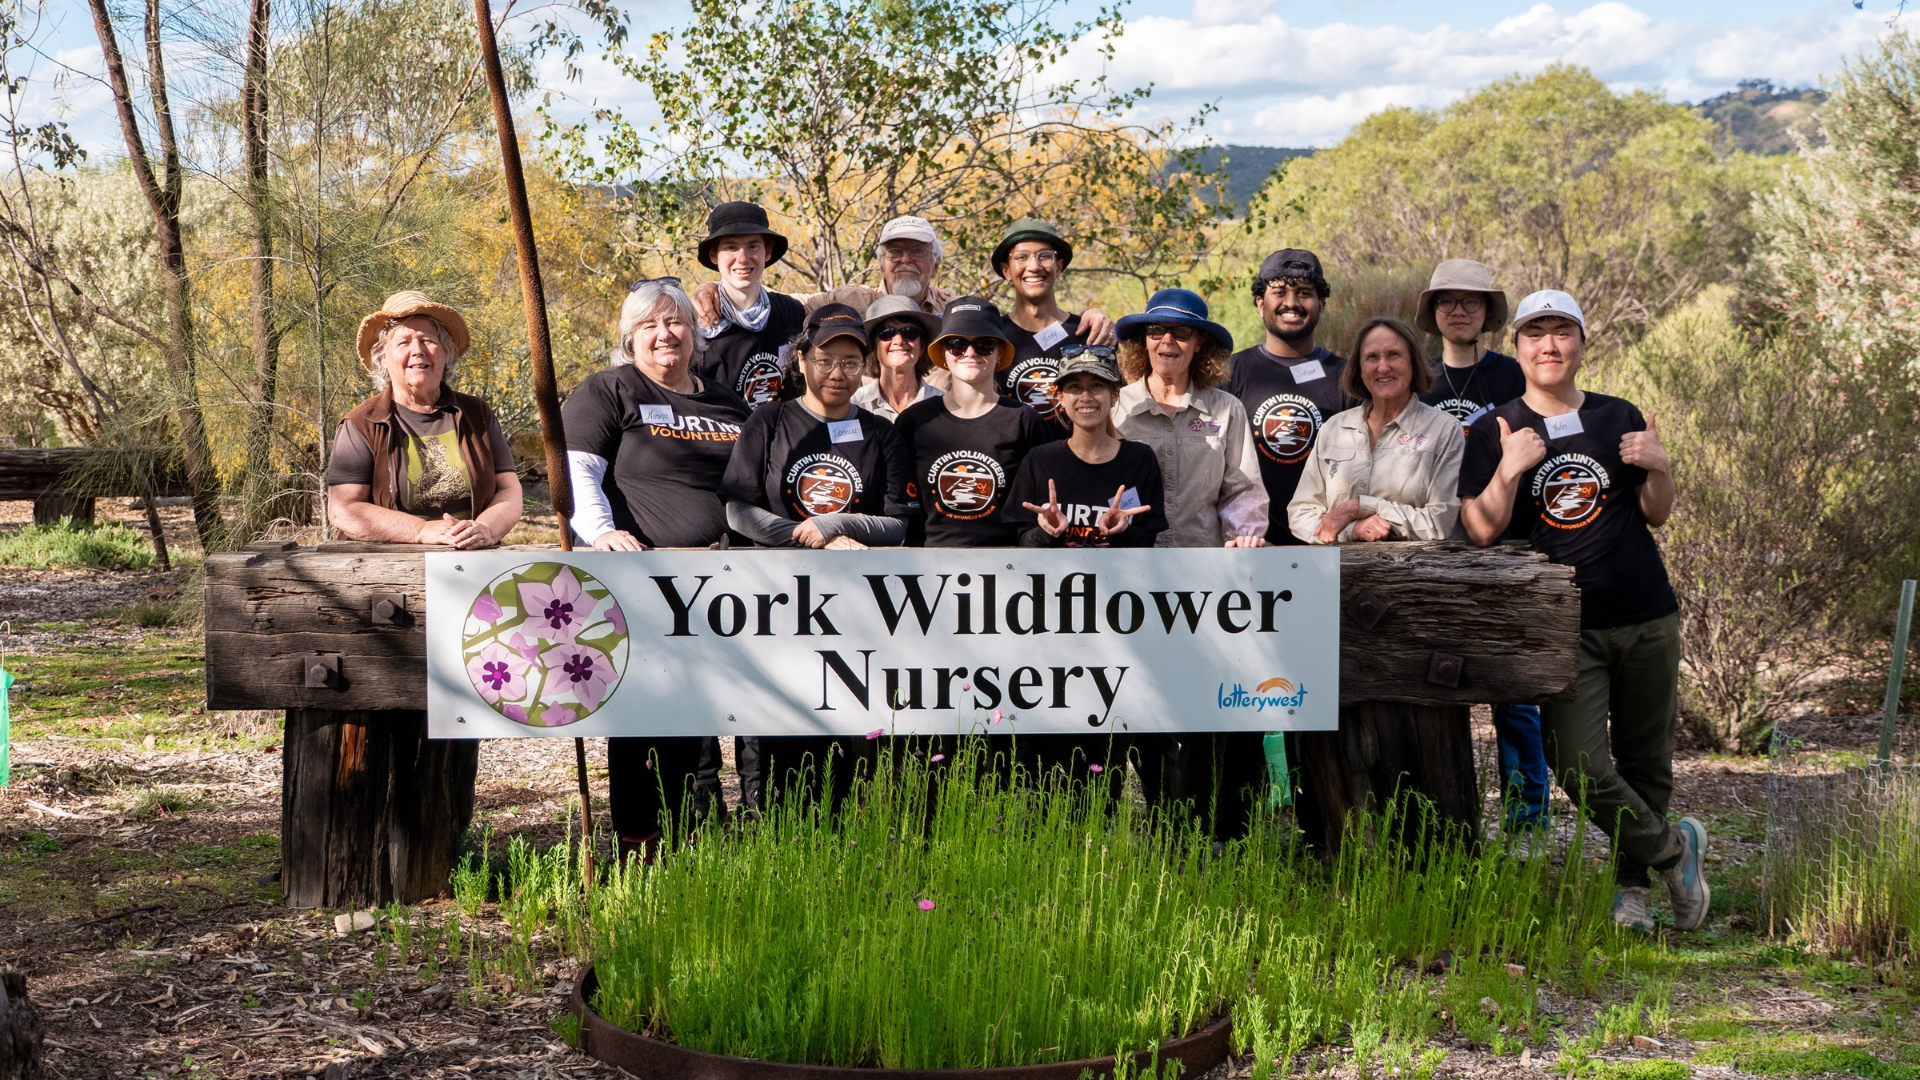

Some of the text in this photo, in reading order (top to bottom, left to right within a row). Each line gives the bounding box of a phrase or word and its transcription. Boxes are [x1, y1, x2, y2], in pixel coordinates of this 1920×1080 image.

[736, 360, 752, 392] CURTIN
[1006, 360, 1028, 388] CURTIN
[652, 415, 742, 434] URTIN
[1253, 395, 1277, 427] CURTIN
[650, 425, 740, 441] VOLUNTEER
[1550, 421, 1568, 435] John
[786, 453, 864, 493] CURTIN VOLUNTEERS!
[927, 452, 953, 484] CURTIN
[1531, 453, 1611, 497] CURTIN VOLUNTEERS!
[648, 573, 1293, 637] York Wildflower
[814, 650, 1130, 728] Nursery
[1218, 682, 1309, 713] lotterywest
